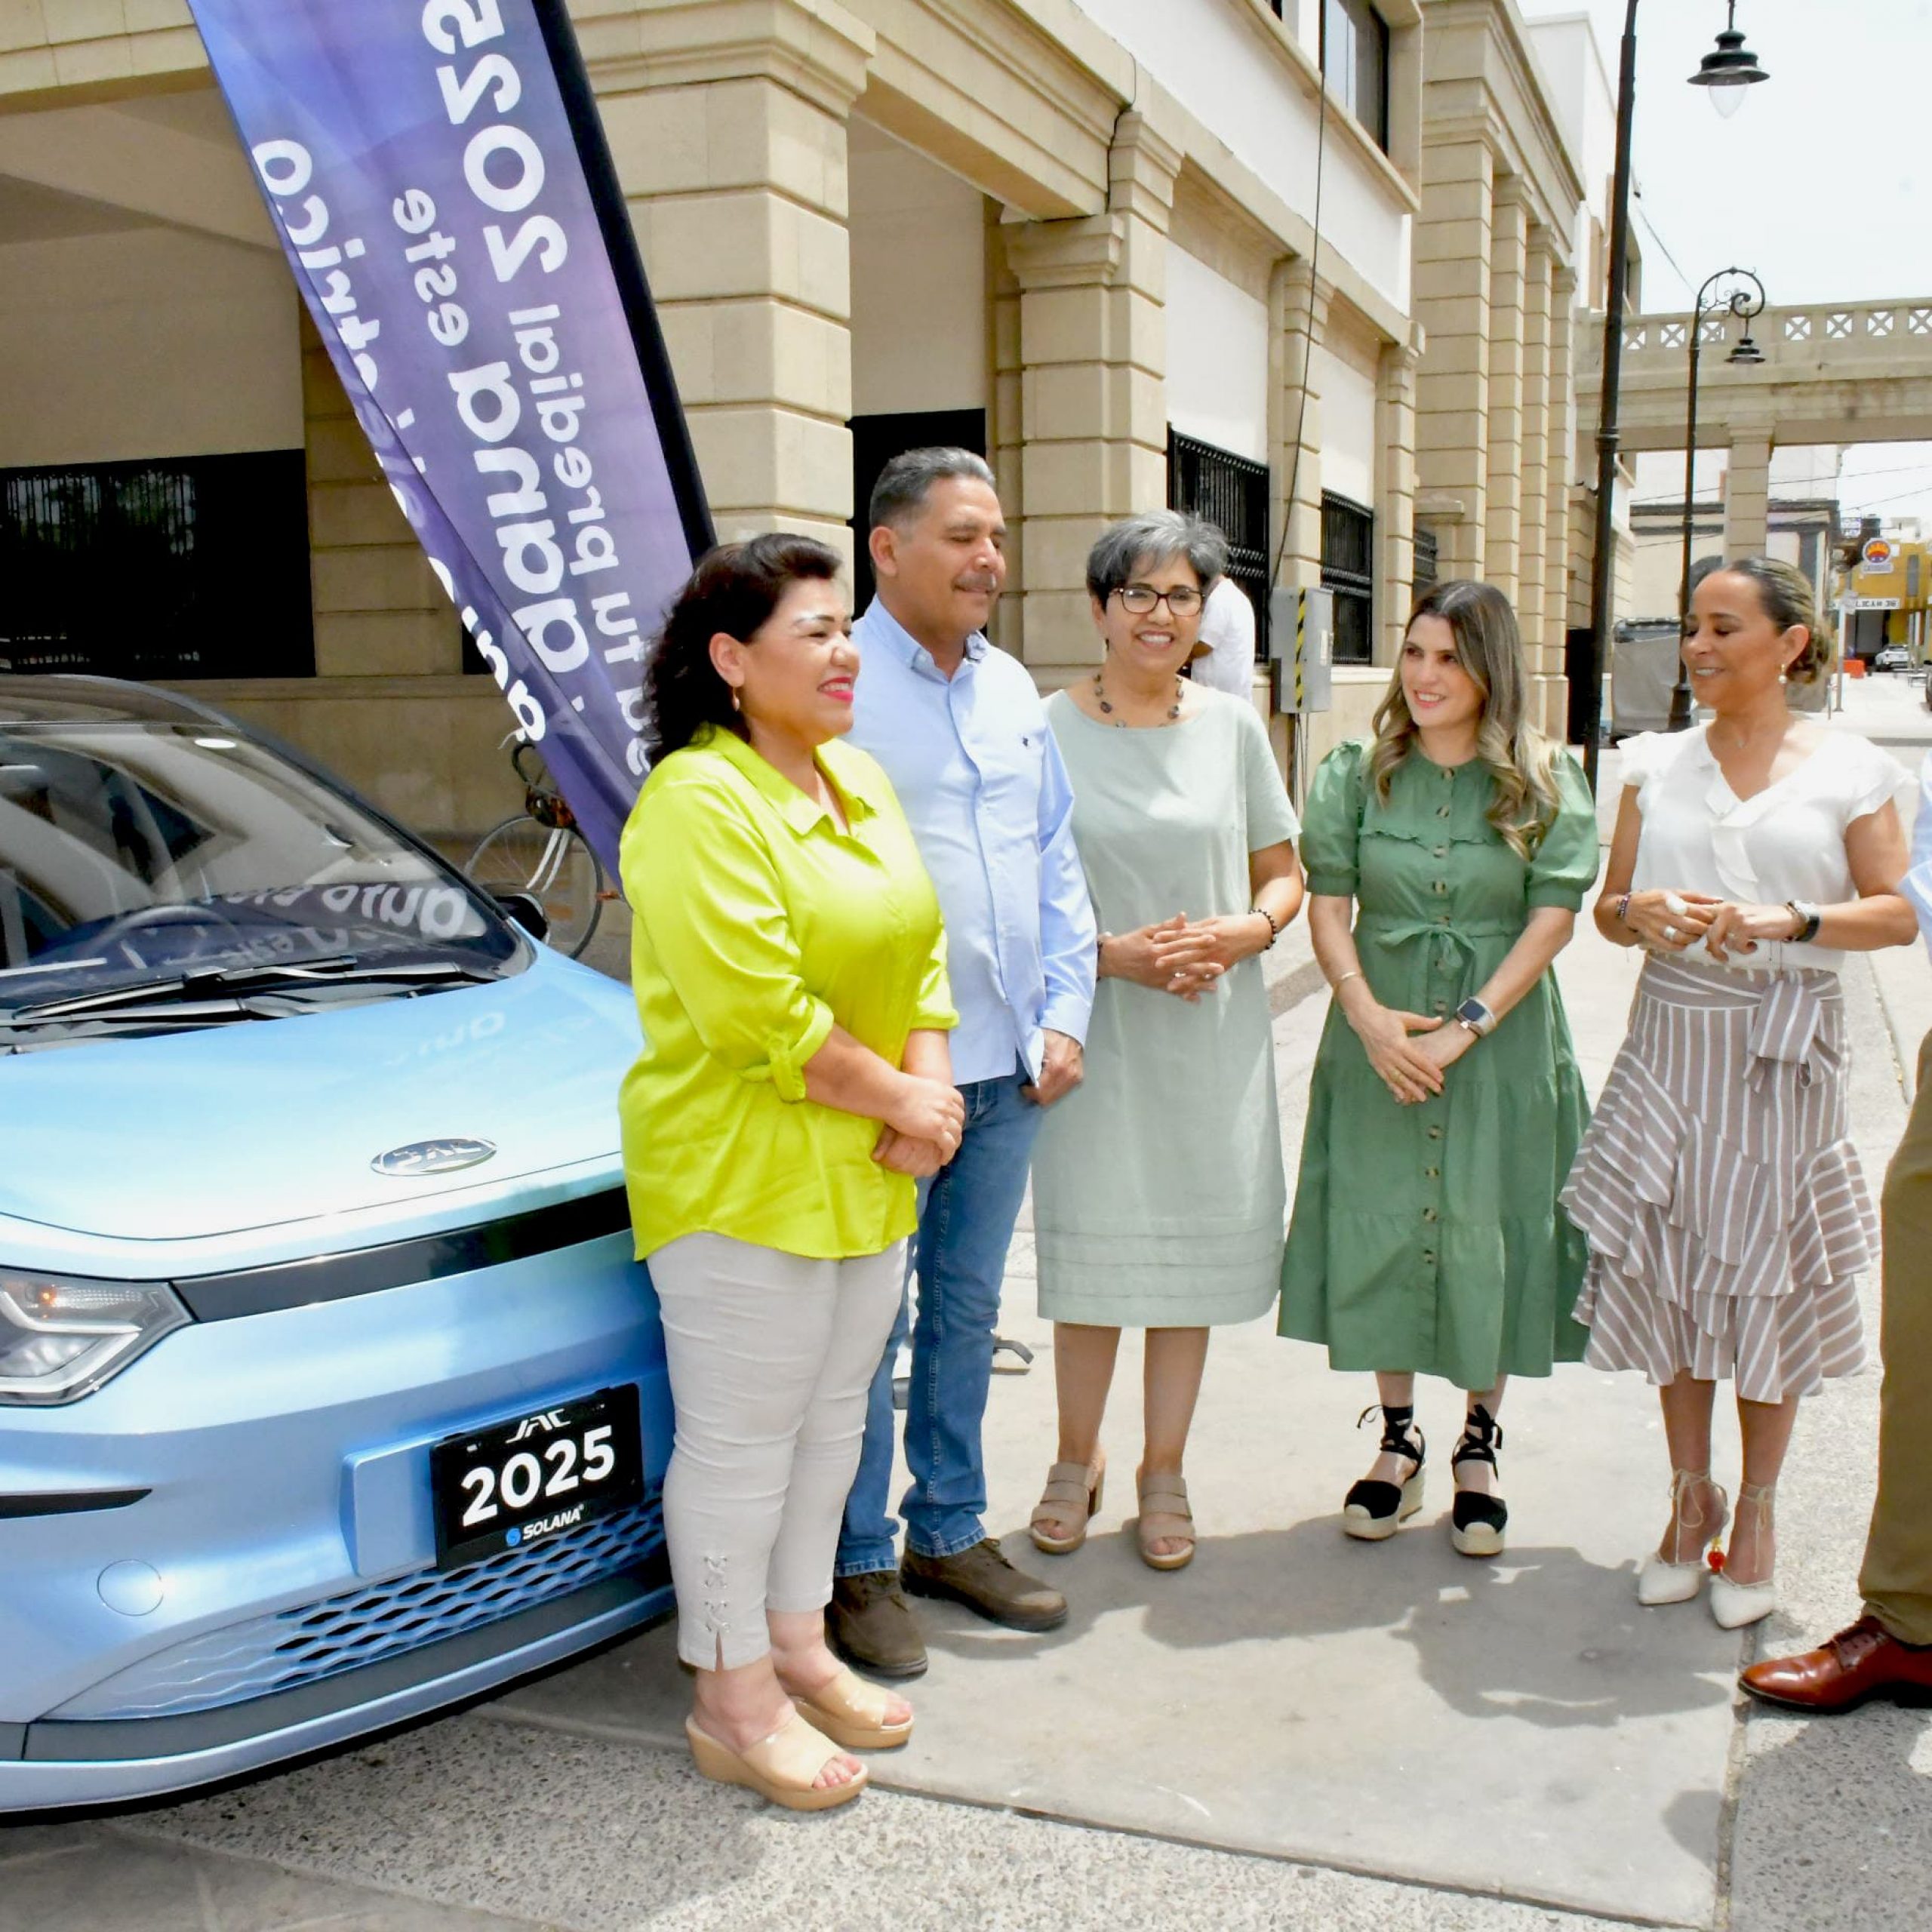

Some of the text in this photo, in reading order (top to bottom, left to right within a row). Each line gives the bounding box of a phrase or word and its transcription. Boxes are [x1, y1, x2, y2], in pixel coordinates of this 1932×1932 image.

[505, 1407, 571, 1444] JAC
[460, 1424, 615, 1527] 2025
[522, 1508, 581, 1540] SOLANA
